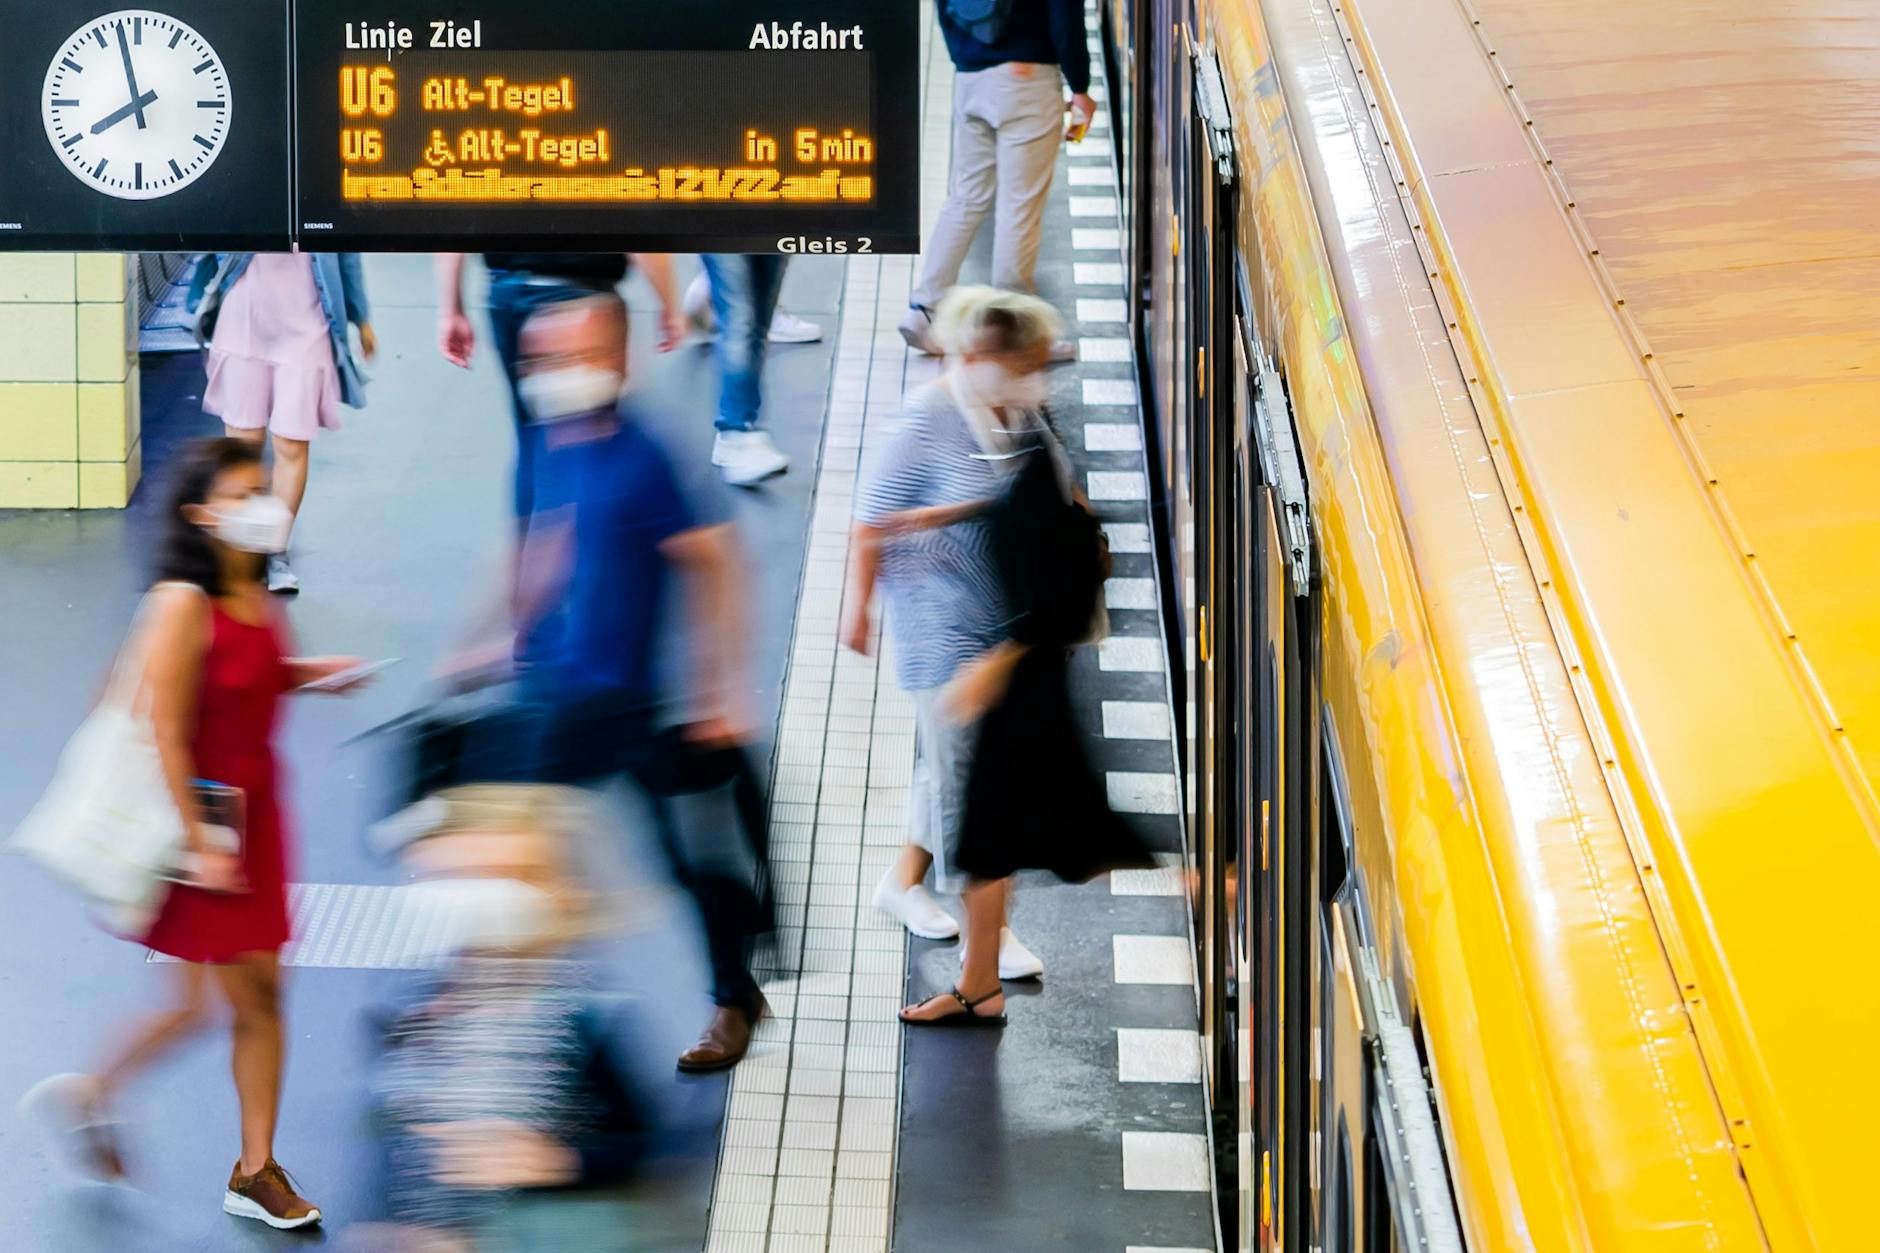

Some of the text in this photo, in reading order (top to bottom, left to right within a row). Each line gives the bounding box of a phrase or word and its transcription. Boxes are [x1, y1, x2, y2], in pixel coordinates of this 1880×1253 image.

[345, 20, 864, 50] Linie Ziel Abfahrt
[341, 67, 574, 115] U6 Alt-Tegel
[342, 130, 382, 162] U6
[459, 130, 611, 165] Alt-Tegel
[746, 129, 778, 162] in
[303, 222, 334, 230] SIEMENS
[776, 236, 873, 253] Gleis 2
